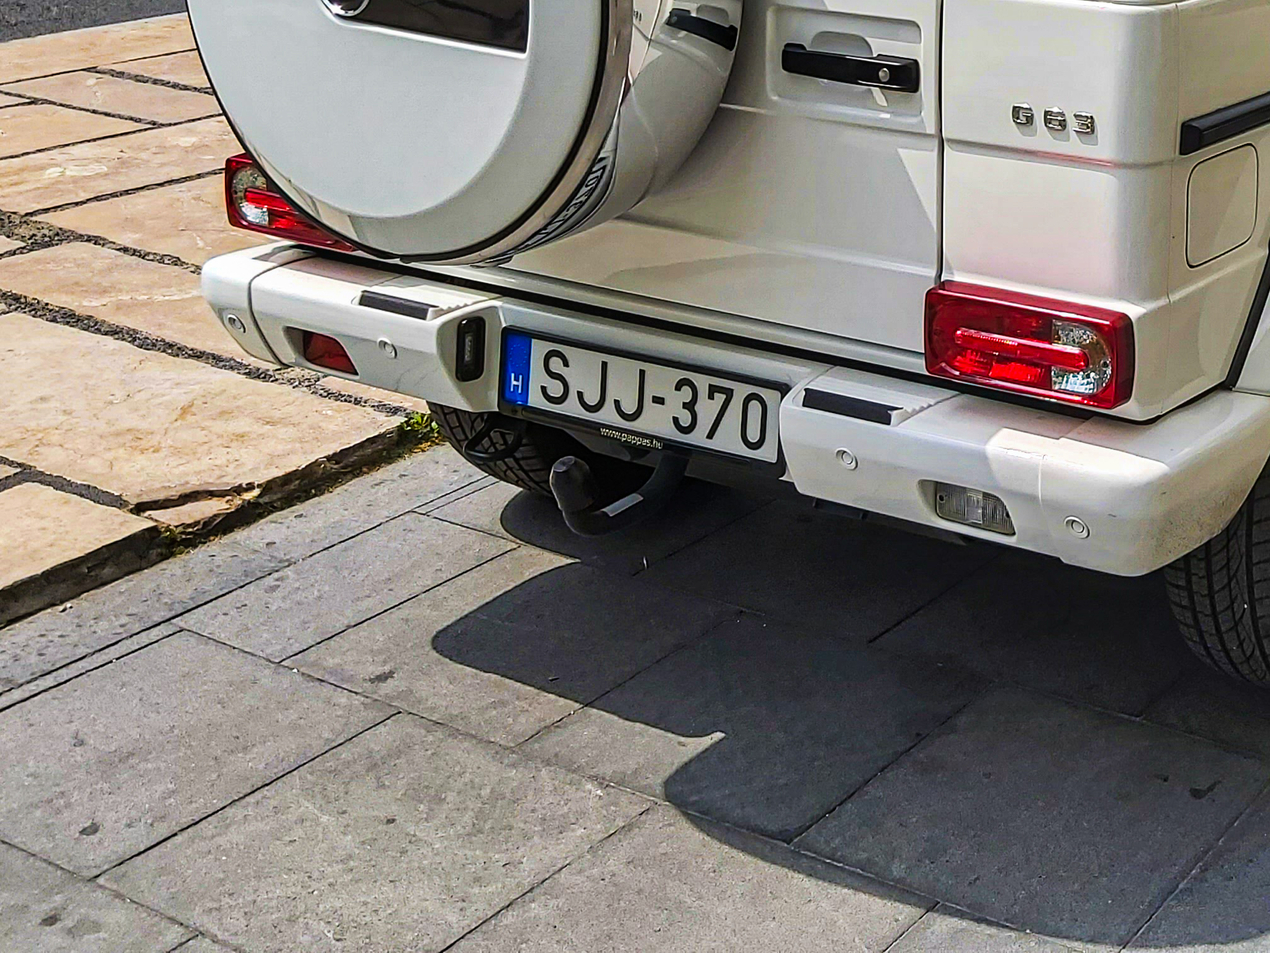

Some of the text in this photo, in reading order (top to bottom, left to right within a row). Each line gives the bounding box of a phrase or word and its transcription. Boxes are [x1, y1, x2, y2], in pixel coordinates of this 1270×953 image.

[509, 372, 523, 394] H
[539, 348, 768, 451] SJJ-370
[599, 427, 664, 450] www.pappas.hu
